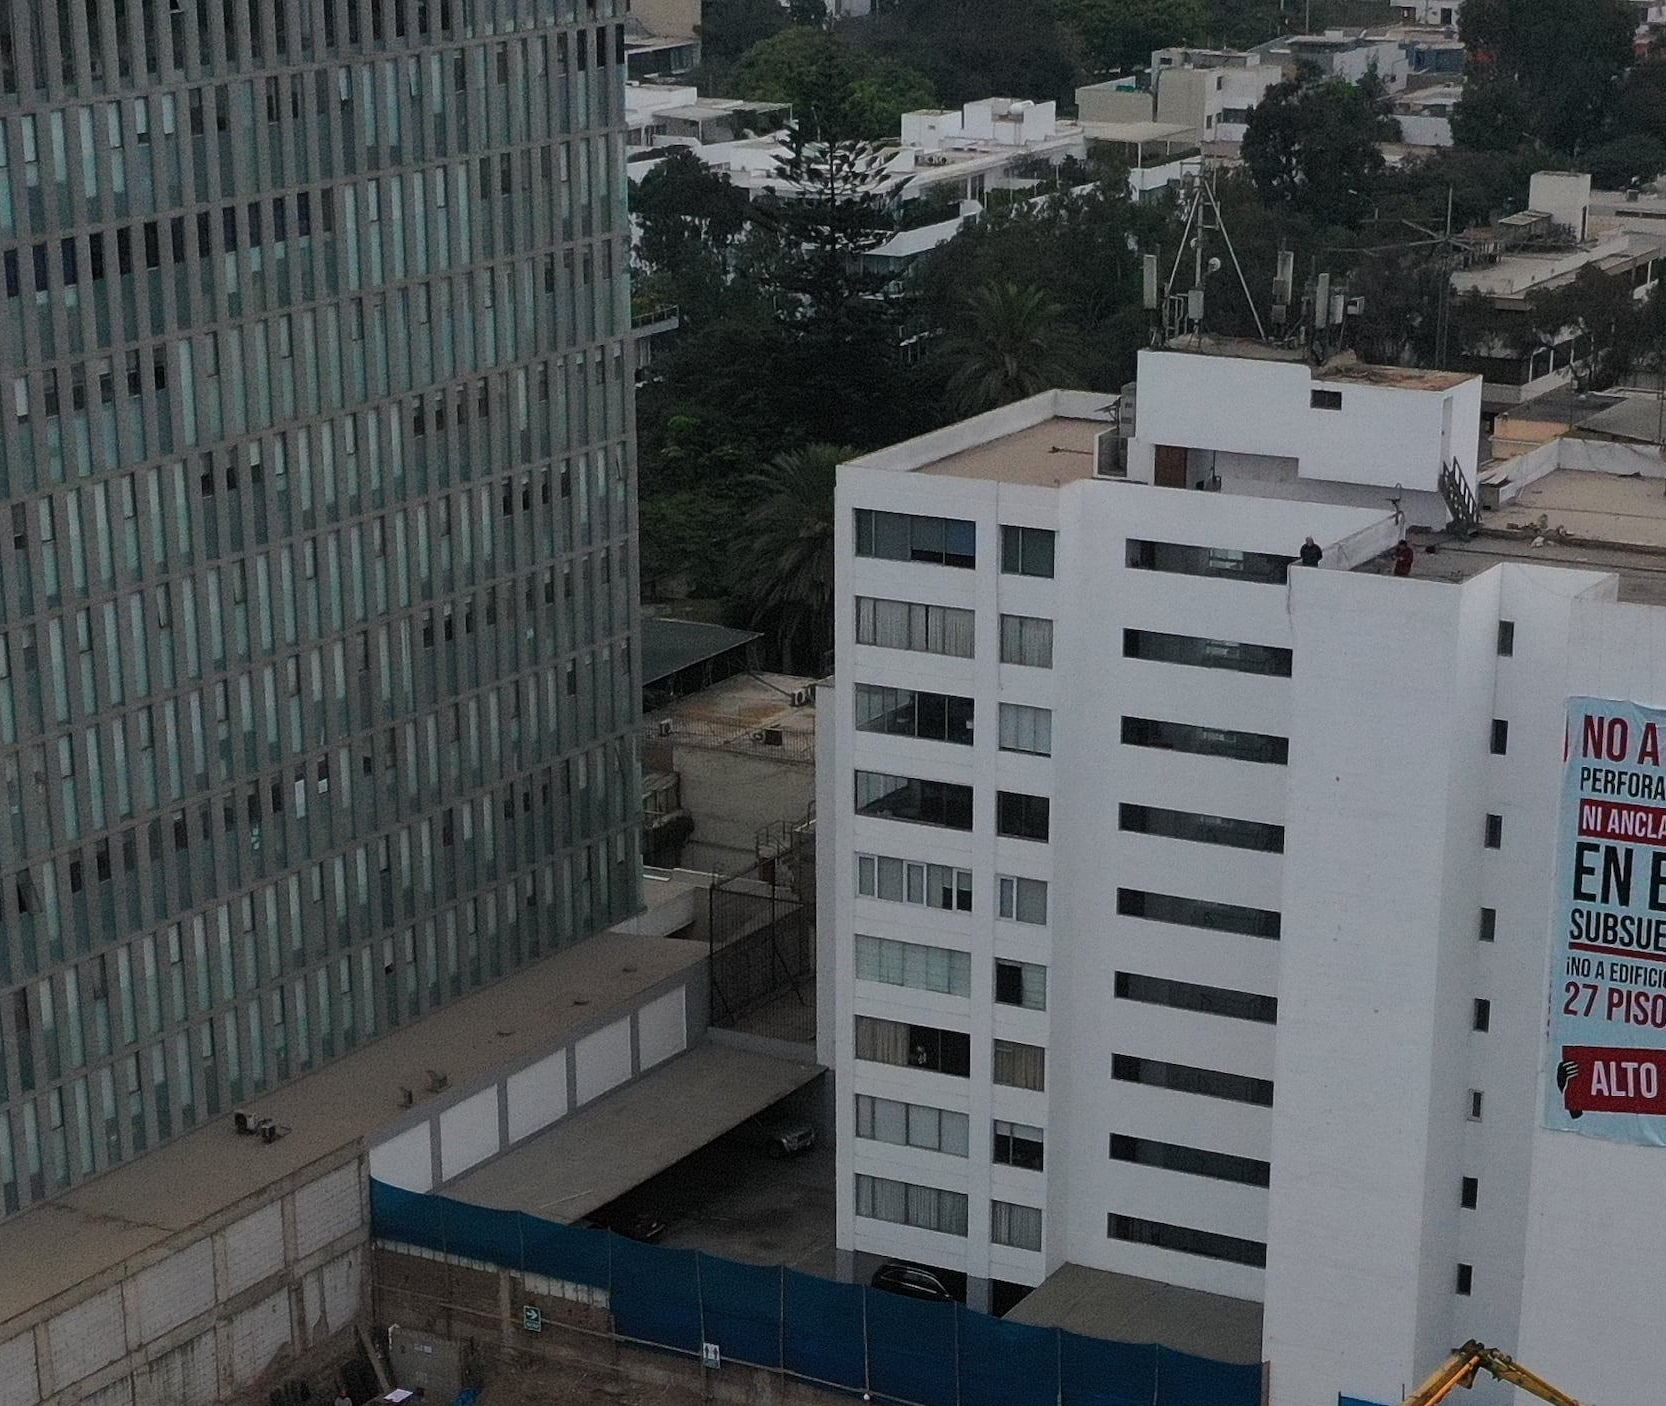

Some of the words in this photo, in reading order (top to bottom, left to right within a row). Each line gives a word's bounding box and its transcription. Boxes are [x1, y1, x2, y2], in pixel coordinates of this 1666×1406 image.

[1583, 715, 1628, 762] NO
[1637, 722, 1660, 767] A
[1582, 805, 1602, 833] NI
[1573, 842, 1634, 907] EN
[1595, 961, 1605, 980] A
[1563, 981, 1599, 1017] 27
[1590, 1060, 1658, 1098] ALTO
